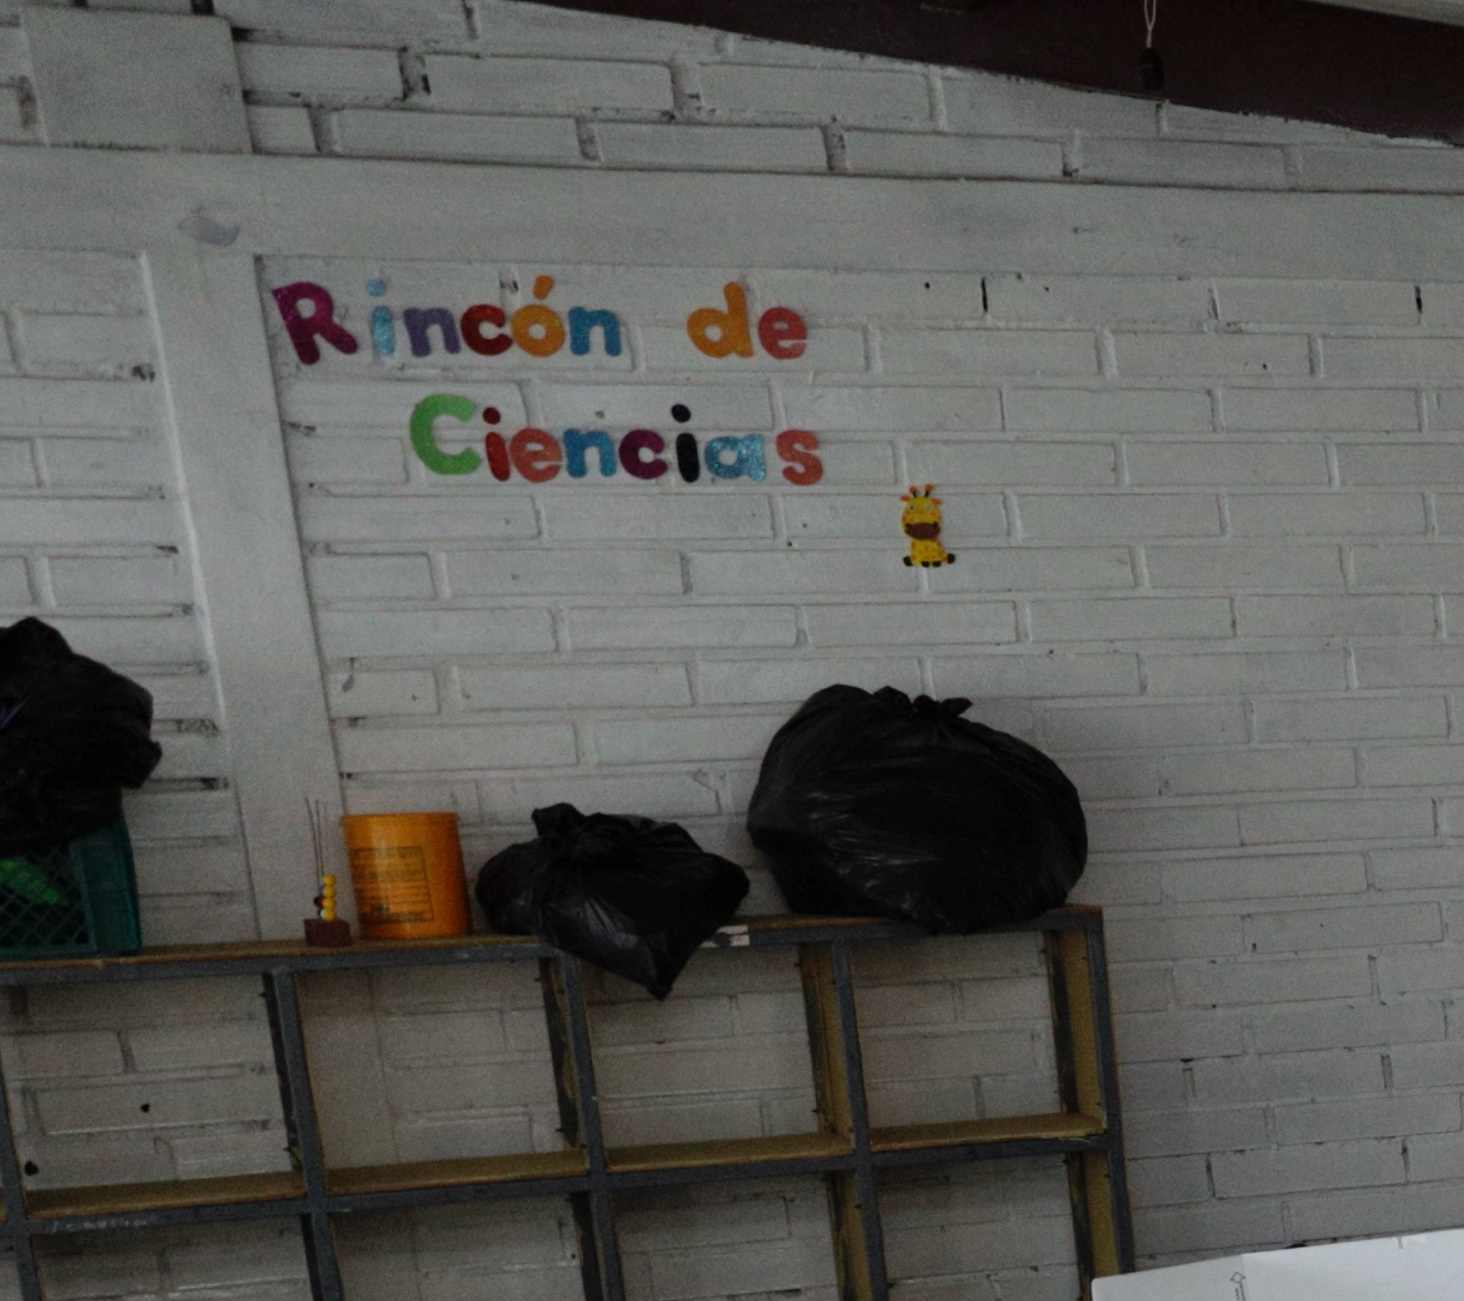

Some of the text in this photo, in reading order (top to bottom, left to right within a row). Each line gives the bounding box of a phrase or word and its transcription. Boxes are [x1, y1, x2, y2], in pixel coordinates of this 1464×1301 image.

[273, 275, 808, 365] Rincón de
[410, 393, 824, 486] Ciencias
